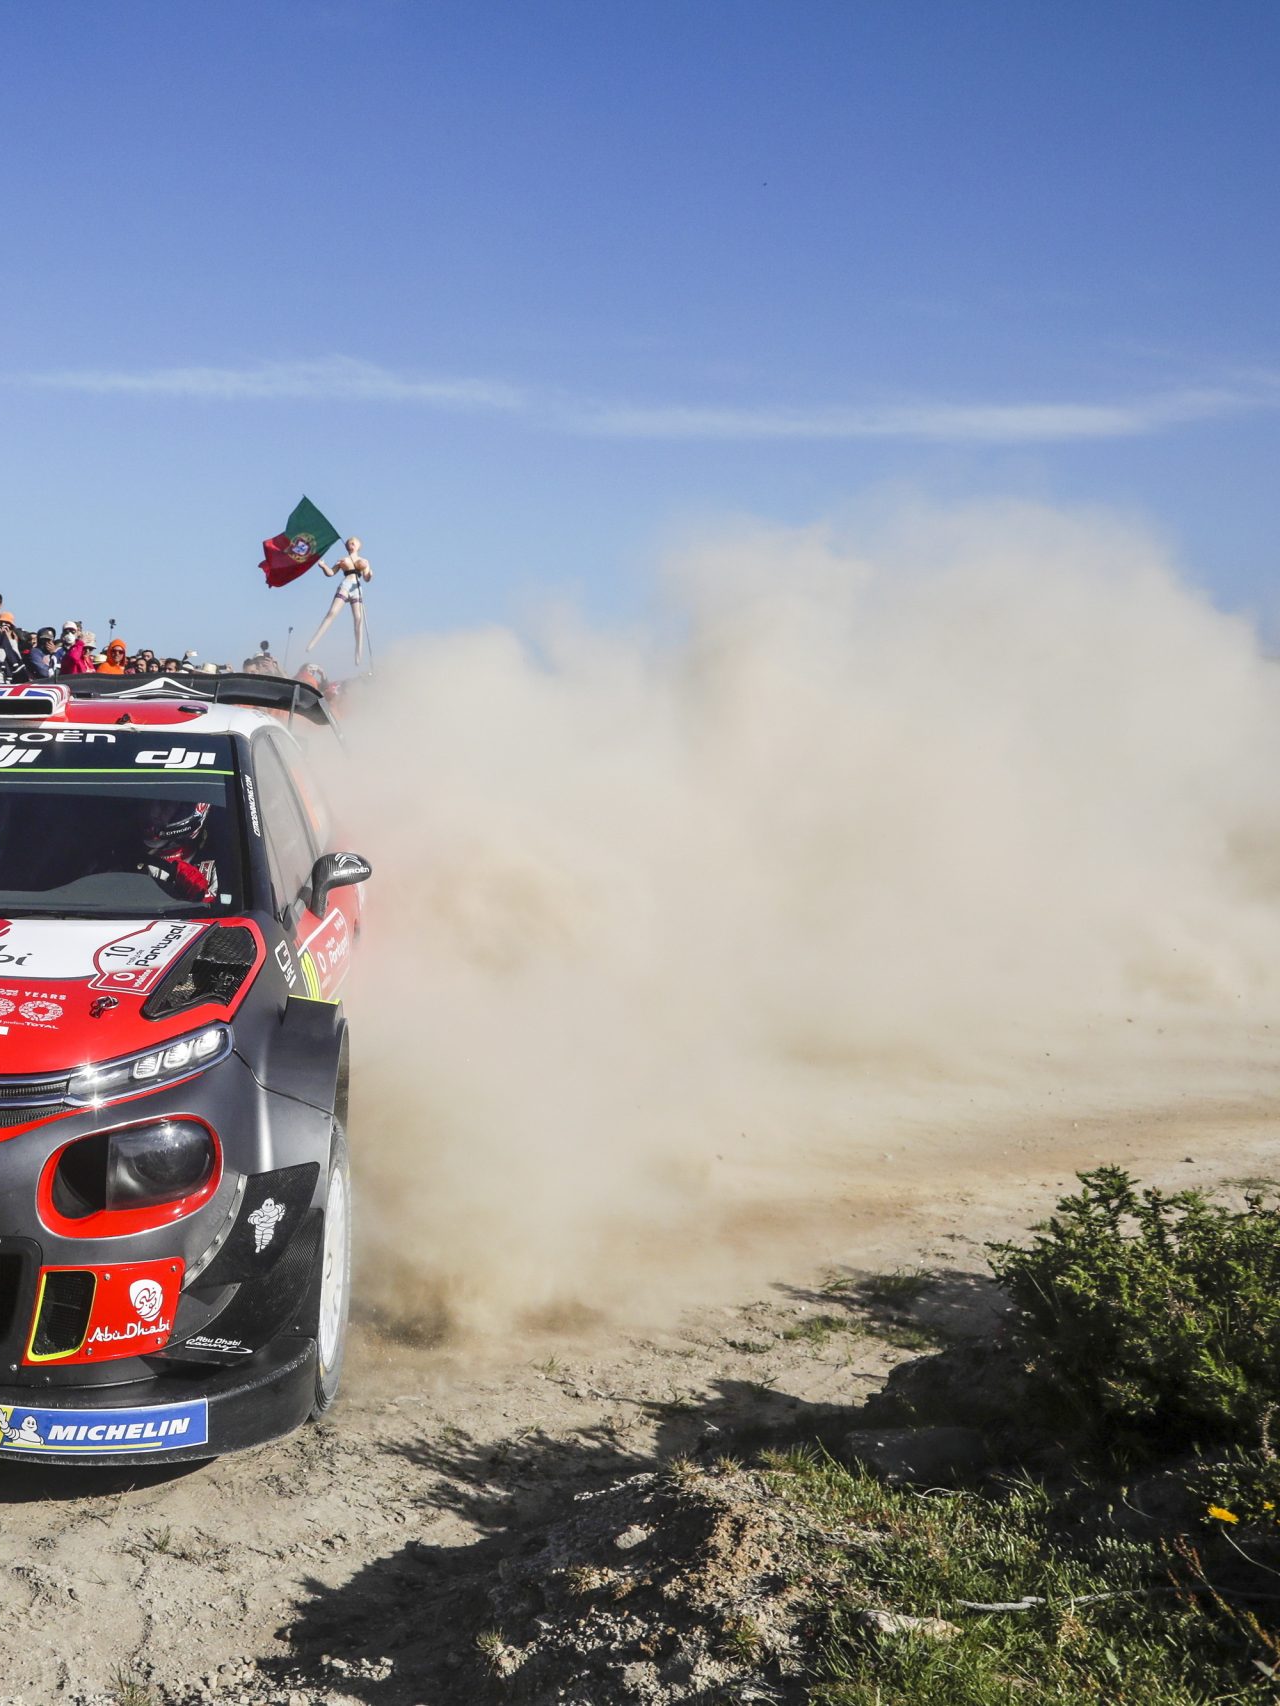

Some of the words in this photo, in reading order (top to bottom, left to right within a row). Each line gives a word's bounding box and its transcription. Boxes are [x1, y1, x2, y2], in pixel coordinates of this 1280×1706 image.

[104, 945, 136, 958] 10
[135, 924, 188, 967] Portugal
[24, 991, 67, 1000] YEARS
[87, 1326, 125, 1343] Abu
[124, 1316, 170, 1339] Dhabi
[47, 1417, 191, 1441] MICHELIN
